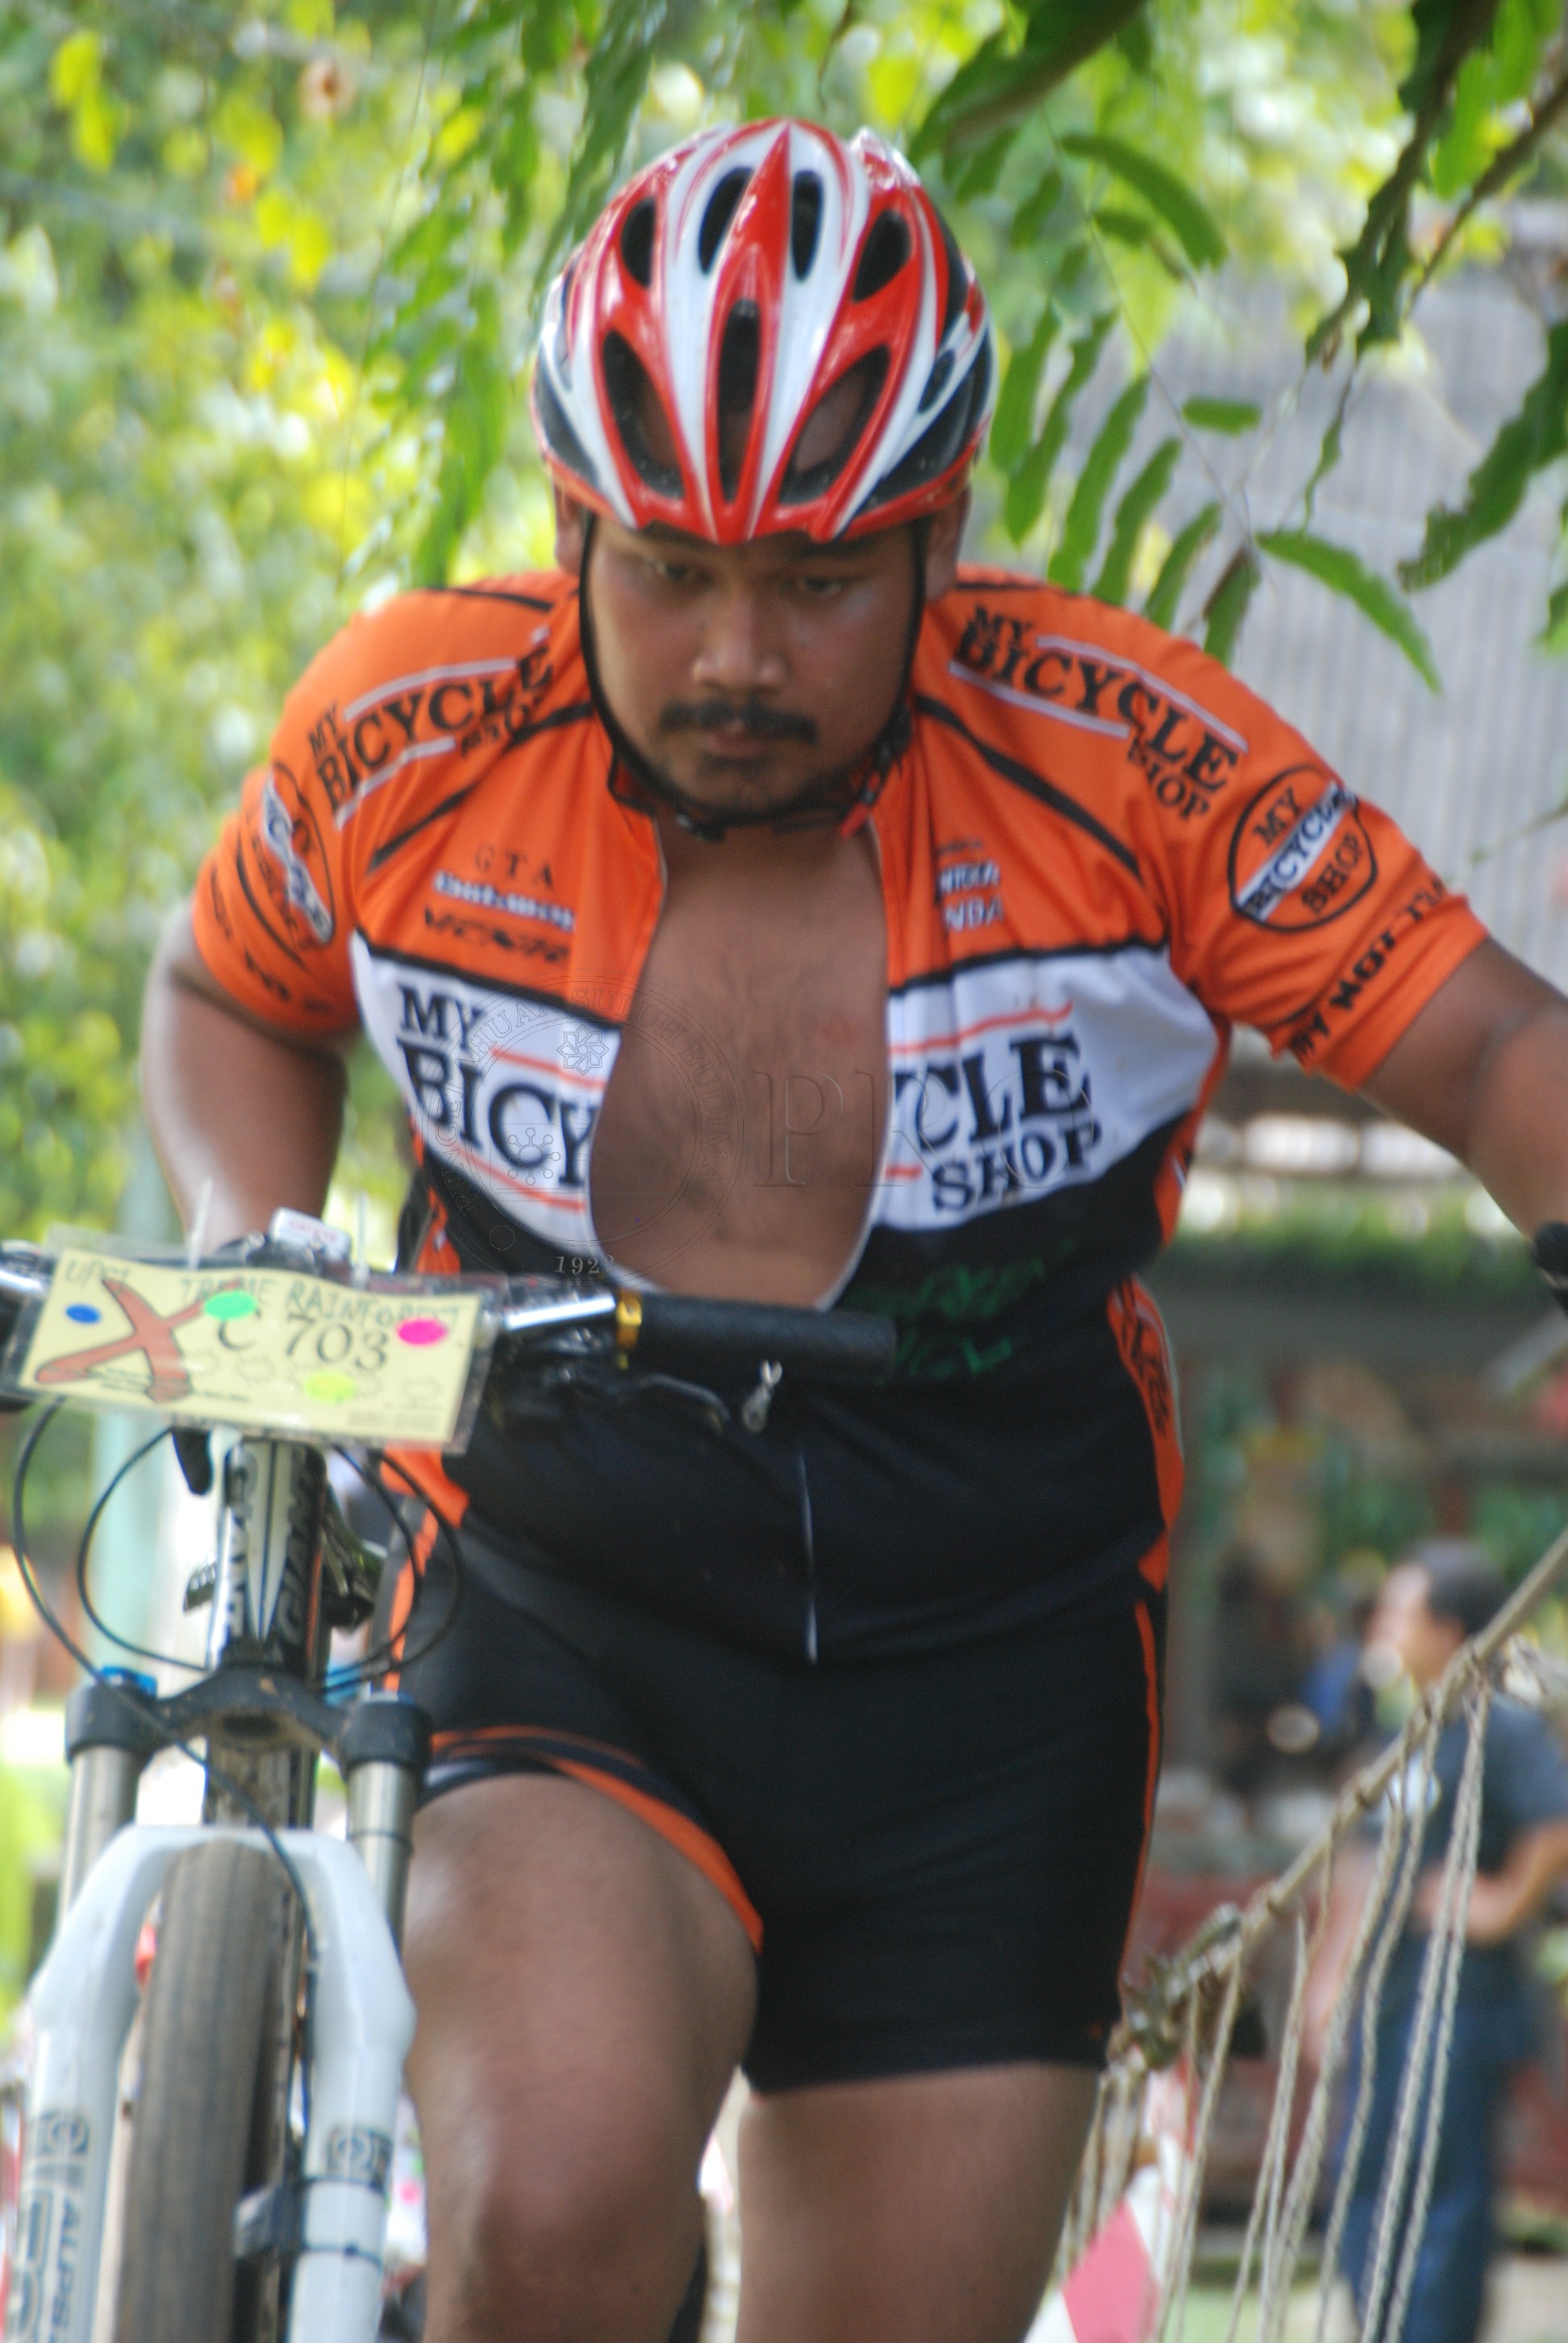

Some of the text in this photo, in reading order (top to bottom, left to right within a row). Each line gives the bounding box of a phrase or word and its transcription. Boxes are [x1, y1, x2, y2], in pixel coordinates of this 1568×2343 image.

[972, 605, 1035, 643] MY
[318, 645, 555, 815] BICYCLE
[953, 620, 1239, 791] BICYCLE
[1253, 786, 1304, 846] MY
[397, 984, 486, 1050] MY
[932, 1117, 1101, 1212] SHOP
[285, 1311, 390, 1373] 703
